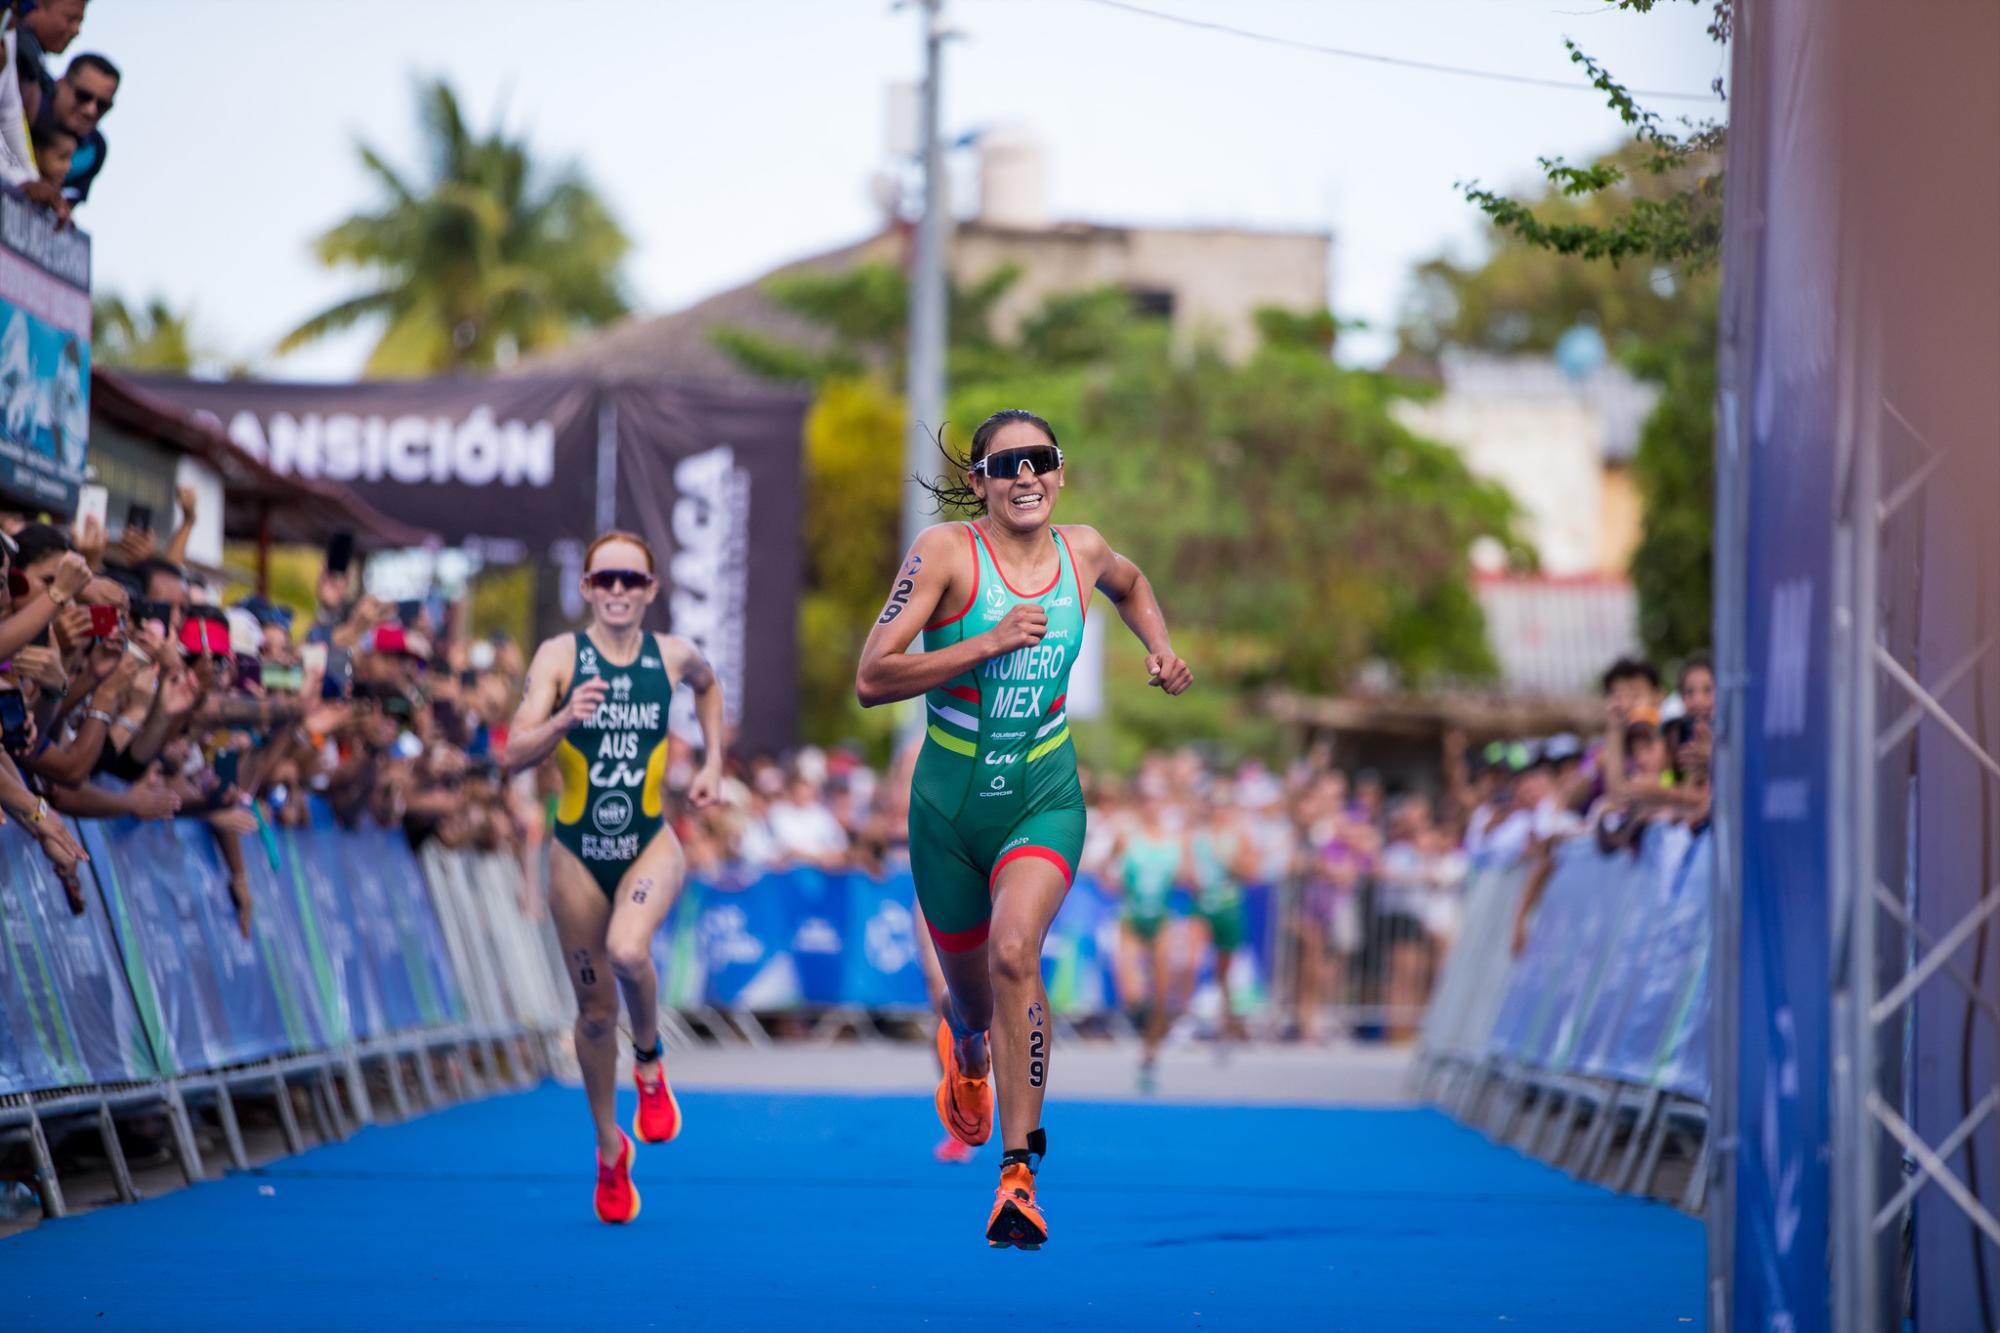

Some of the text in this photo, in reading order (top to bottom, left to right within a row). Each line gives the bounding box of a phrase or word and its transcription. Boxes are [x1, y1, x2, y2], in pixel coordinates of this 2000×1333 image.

[196, 404, 555, 487] ANSICIÓN
[878, 578, 914, 624] 29
[984, 644, 1065, 680] ROMERO
[990, 685, 1044, 718] MEX
[598, 732, 640, 759] AUS
[1029, 1030, 1045, 1088] 29
